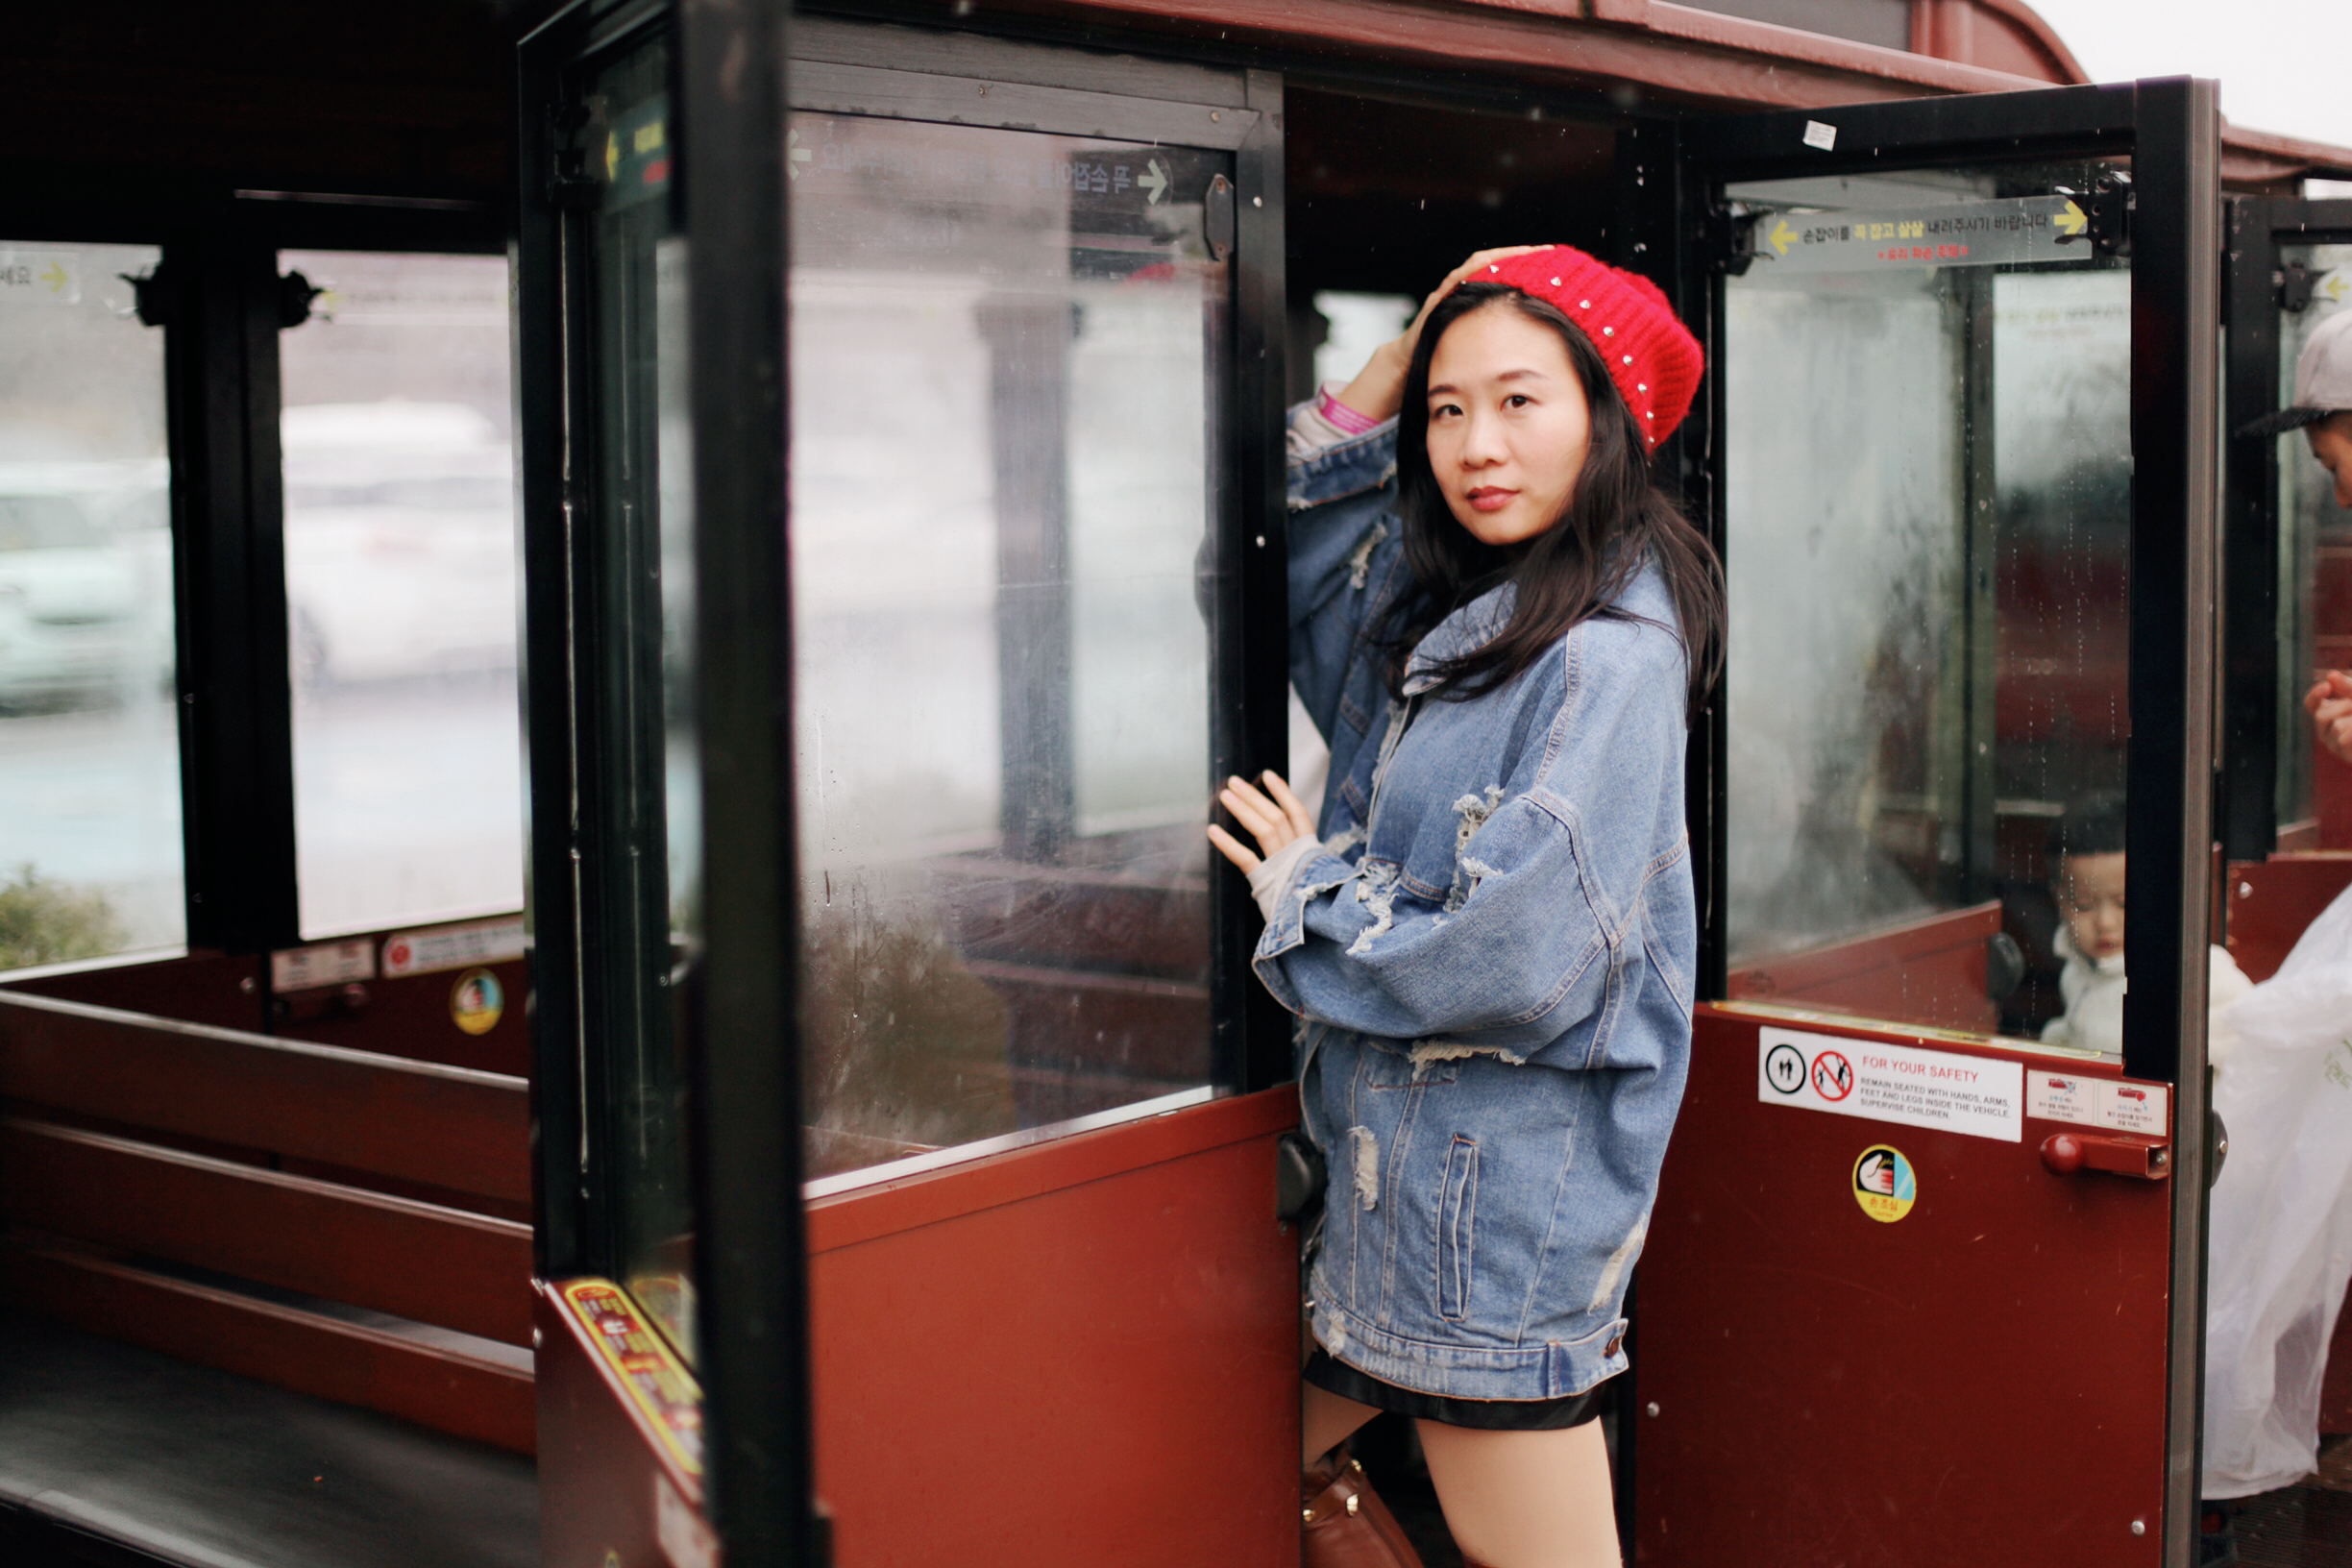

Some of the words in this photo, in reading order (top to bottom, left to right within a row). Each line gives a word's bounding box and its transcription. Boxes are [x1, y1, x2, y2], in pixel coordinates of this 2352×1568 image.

[1802, 224, 1850, 245] 손잡이를
[1869, 222, 1896, 241] 잡고
[1898, 219, 1924, 240] 살살
[1927, 216, 1990, 234] 내려주시기
[1994, 212, 2048, 232] 바랍니다
[1862, 1056, 1888, 1069] FOR
[1891, 1061, 1926, 1075] YOUR
[1929, 1066, 1979, 1084] SAFETY
[1860, 1077, 1892, 1090] REMAIN
[1894, 1082, 1924, 1094] SEATED
[1927, 1087, 1948, 1098] WITH
[1949, 1090, 1981, 1104] HANDS,
[1983, 1095, 2010, 1108] ARMS,
[1860, 1088, 1880, 1098] FEET
[1882, 1091, 1900, 1101] AND
[1901, 1094, 1923, 1106] LEGS
[1925, 1098, 1952, 1110] INSIDE
[1955, 1103, 1971, 1113] THE
[1972, 1105, 2011, 1119] VEHICLE.
[1860, 1098, 1905, 1113] SUPERVISE
[1907, 1105, 1951, 1119] CHILDREN.
